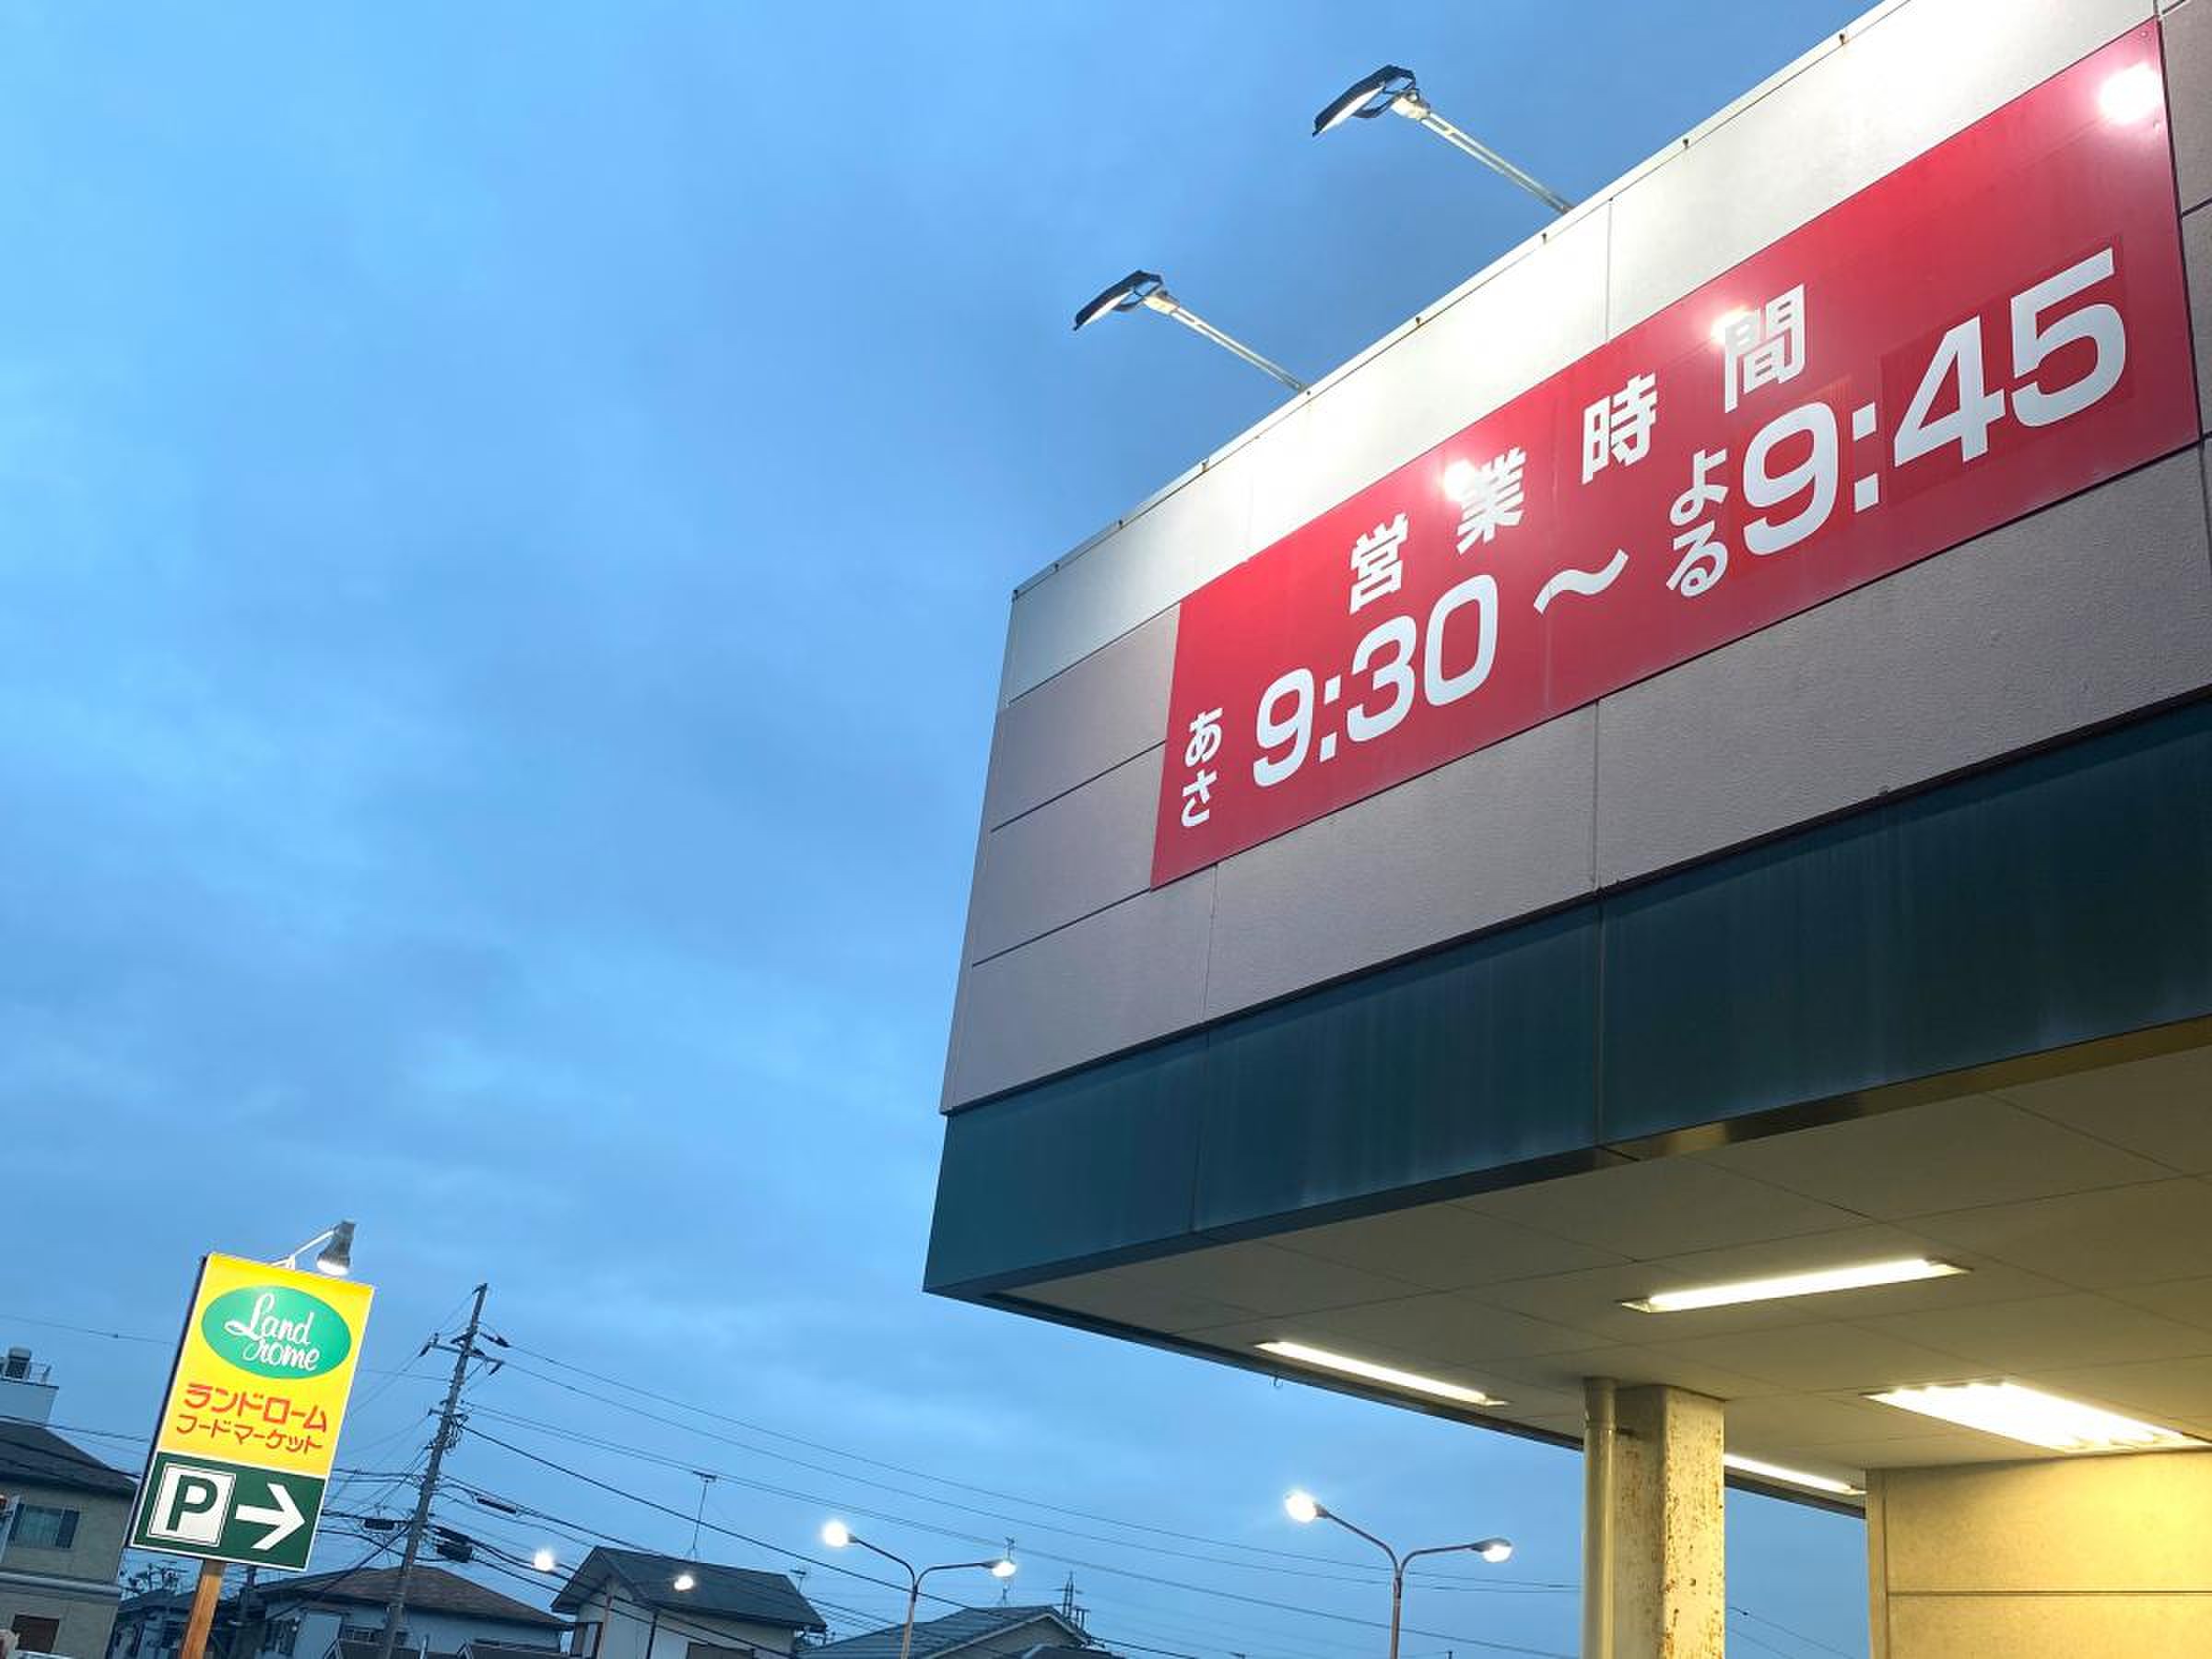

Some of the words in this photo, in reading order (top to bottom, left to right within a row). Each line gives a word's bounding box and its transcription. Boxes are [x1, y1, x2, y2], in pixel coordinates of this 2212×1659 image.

[1349, 284, 1806, 614] 営業時間
[1181, 708, 1224, 828] あさ
[1253, 574, 1499, 786] 9:30
[1666, 448, 1729, 597] よる
[1743, 247, 2126, 555] 9:45
[225, 1293, 314, 1346] Land
[176, 1415, 324, 1455] フードマーケット
[183, 1382, 327, 1433] ランドローム
[166, 1475, 219, 1535] P
